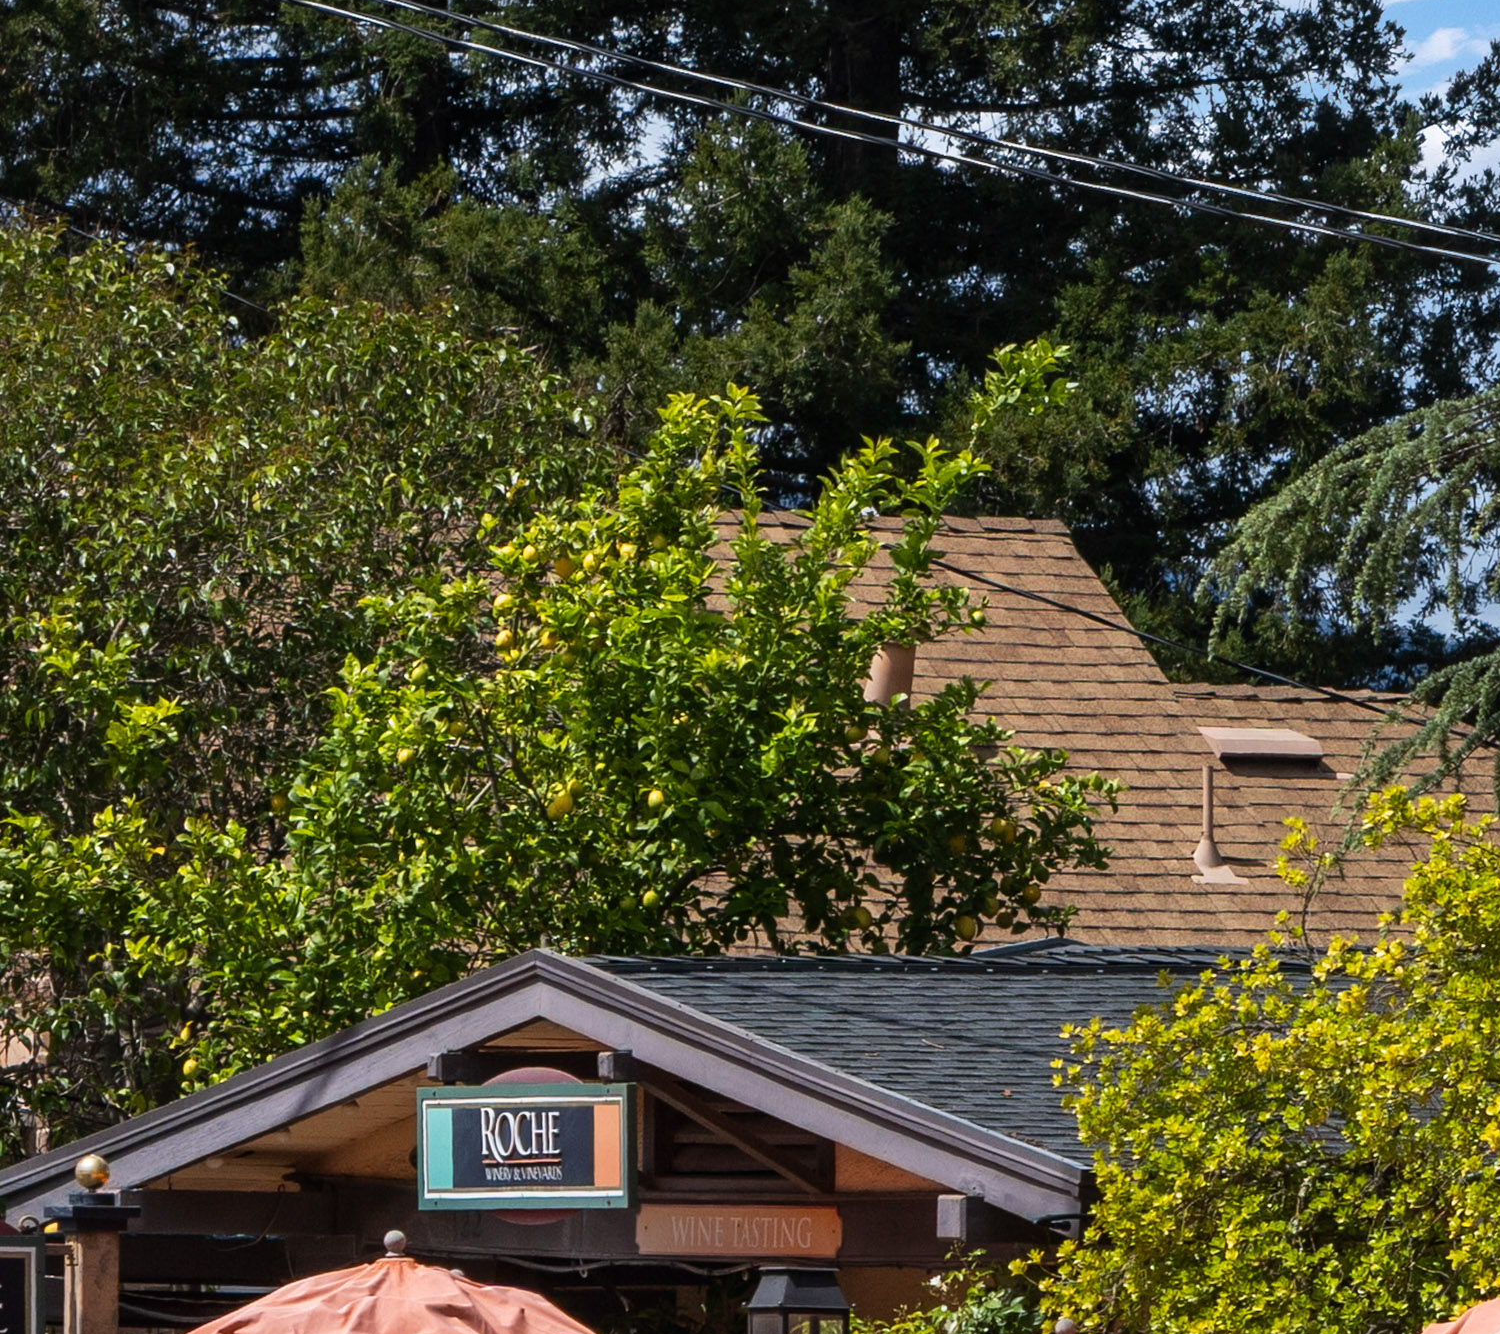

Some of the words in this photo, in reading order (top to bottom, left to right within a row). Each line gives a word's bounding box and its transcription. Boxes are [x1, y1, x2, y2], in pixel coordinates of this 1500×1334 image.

[480, 1107, 561, 1163] ROCHE
[485, 1166, 512, 1181] WINERY
[513, 1168, 521, 1181] &
[521, 1166, 562, 1181] VINEYARDS
[671, 1215, 724, 1248] WINE
[732, 1216, 812, 1249] TASTING
